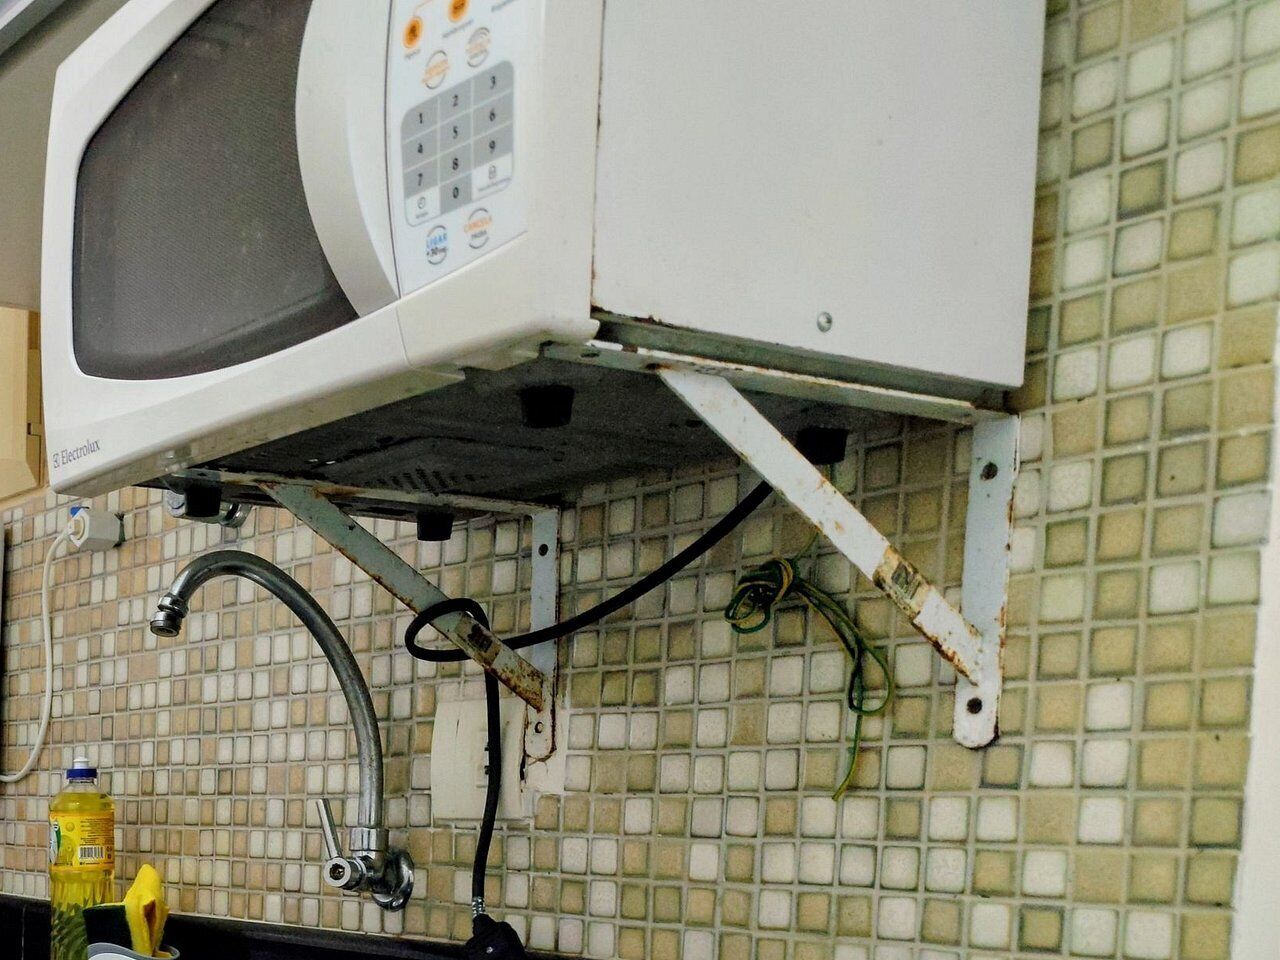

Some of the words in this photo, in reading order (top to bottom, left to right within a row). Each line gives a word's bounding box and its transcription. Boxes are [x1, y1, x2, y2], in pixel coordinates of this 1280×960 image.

[418, 112, 423, 124] 1
[452, 94, 459, 107] 2
[489, 75, 496, 89] 3
[417, 142, 423, 154] 4
[452, 125, 459, 139] 5
[489, 108, 496, 122] 6
[417, 172, 423, 186] 7
[452, 157, 459, 171] 8
[489, 140, 496, 154] 9
[452, 186, 459, 199] 0
[61, 440, 100, 465] Electrolux
